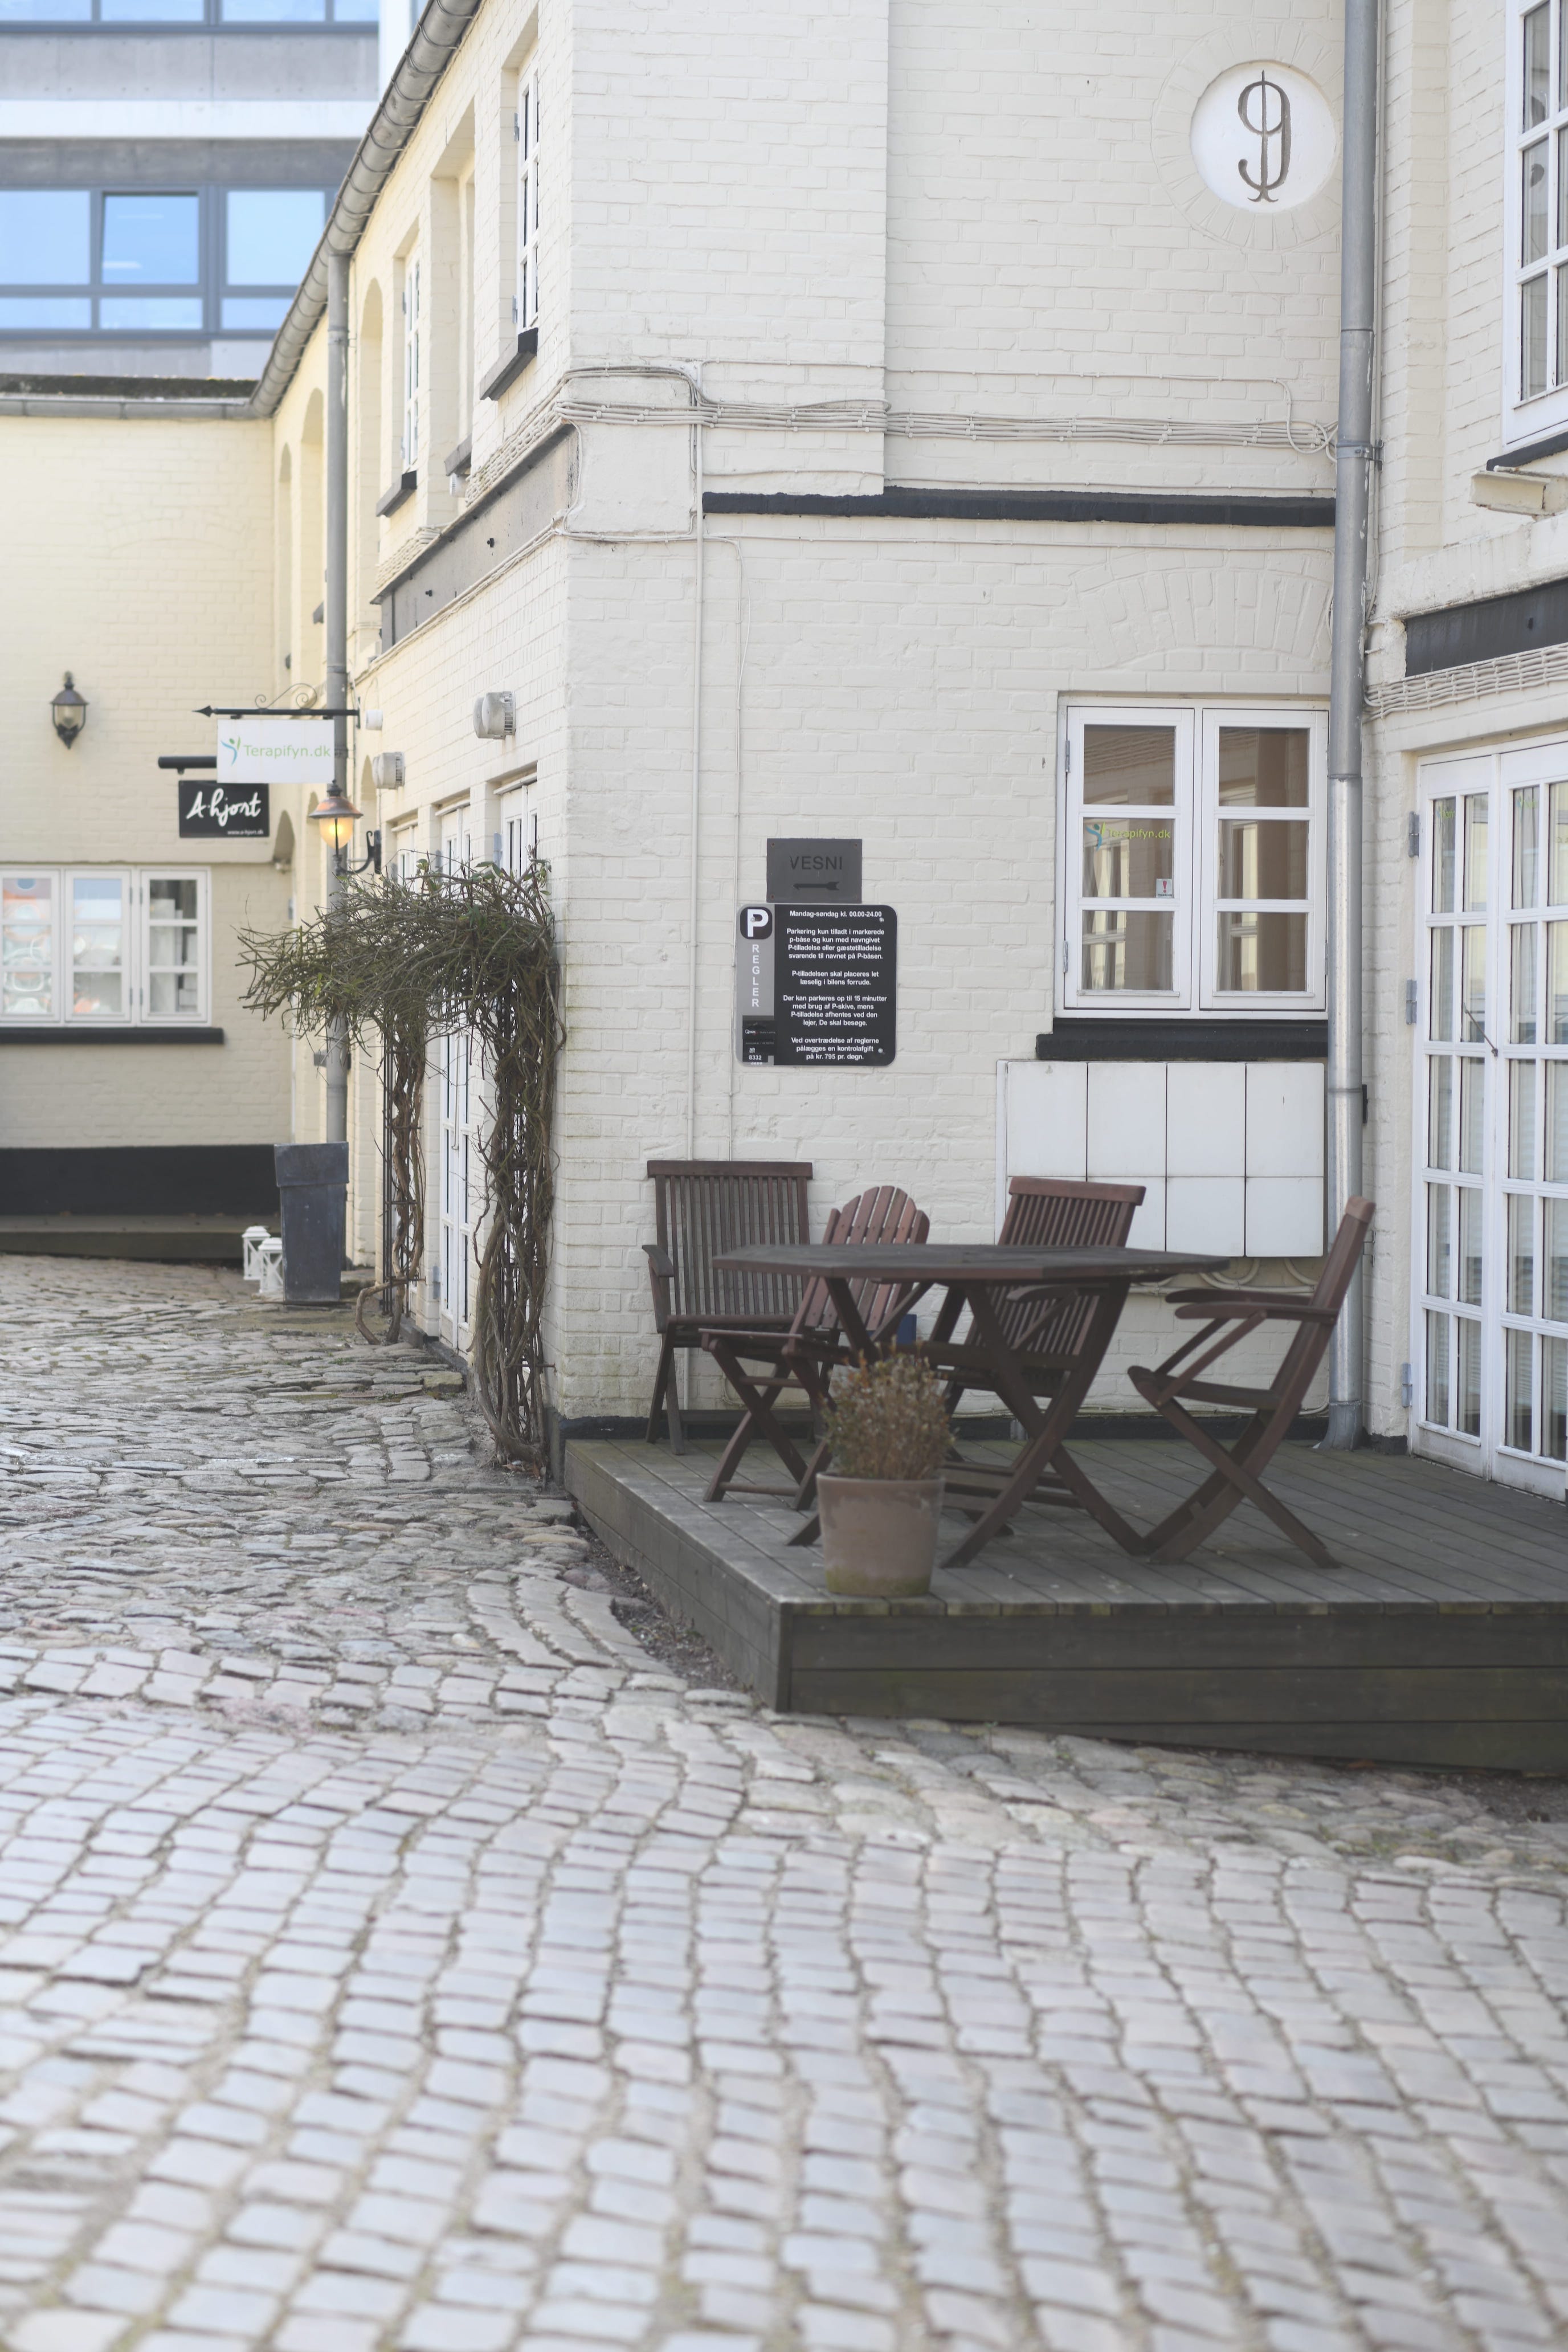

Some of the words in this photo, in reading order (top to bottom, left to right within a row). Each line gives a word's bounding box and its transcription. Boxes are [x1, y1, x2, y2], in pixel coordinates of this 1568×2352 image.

[243, 745, 331, 760] Terapifyn.dk
[1109, 829, 1170, 839] Terapifyn.dk
[789, 856, 843, 869] VESNI
[747, 909, 769, 937] P
